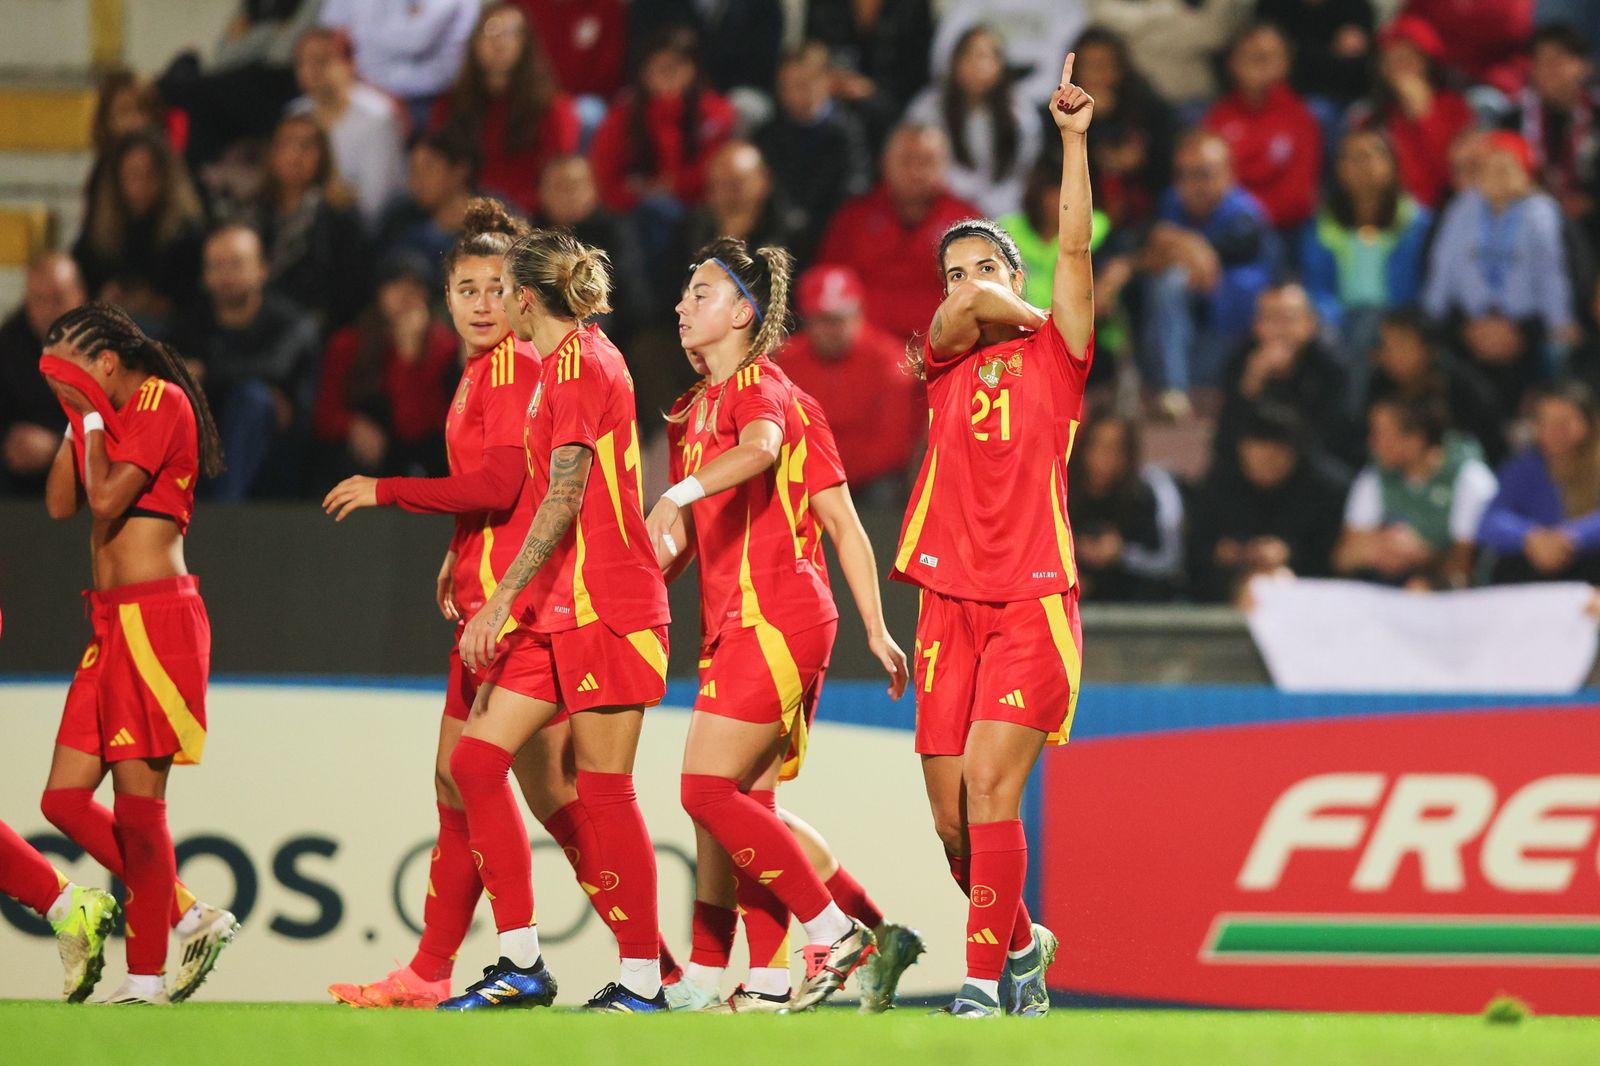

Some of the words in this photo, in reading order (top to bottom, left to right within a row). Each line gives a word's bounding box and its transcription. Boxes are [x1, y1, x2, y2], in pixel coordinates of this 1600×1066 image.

[971, 389, 1010, 441] 21
[915, 637, 941, 693] 1
[1235, 771, 1600, 893] FRE
